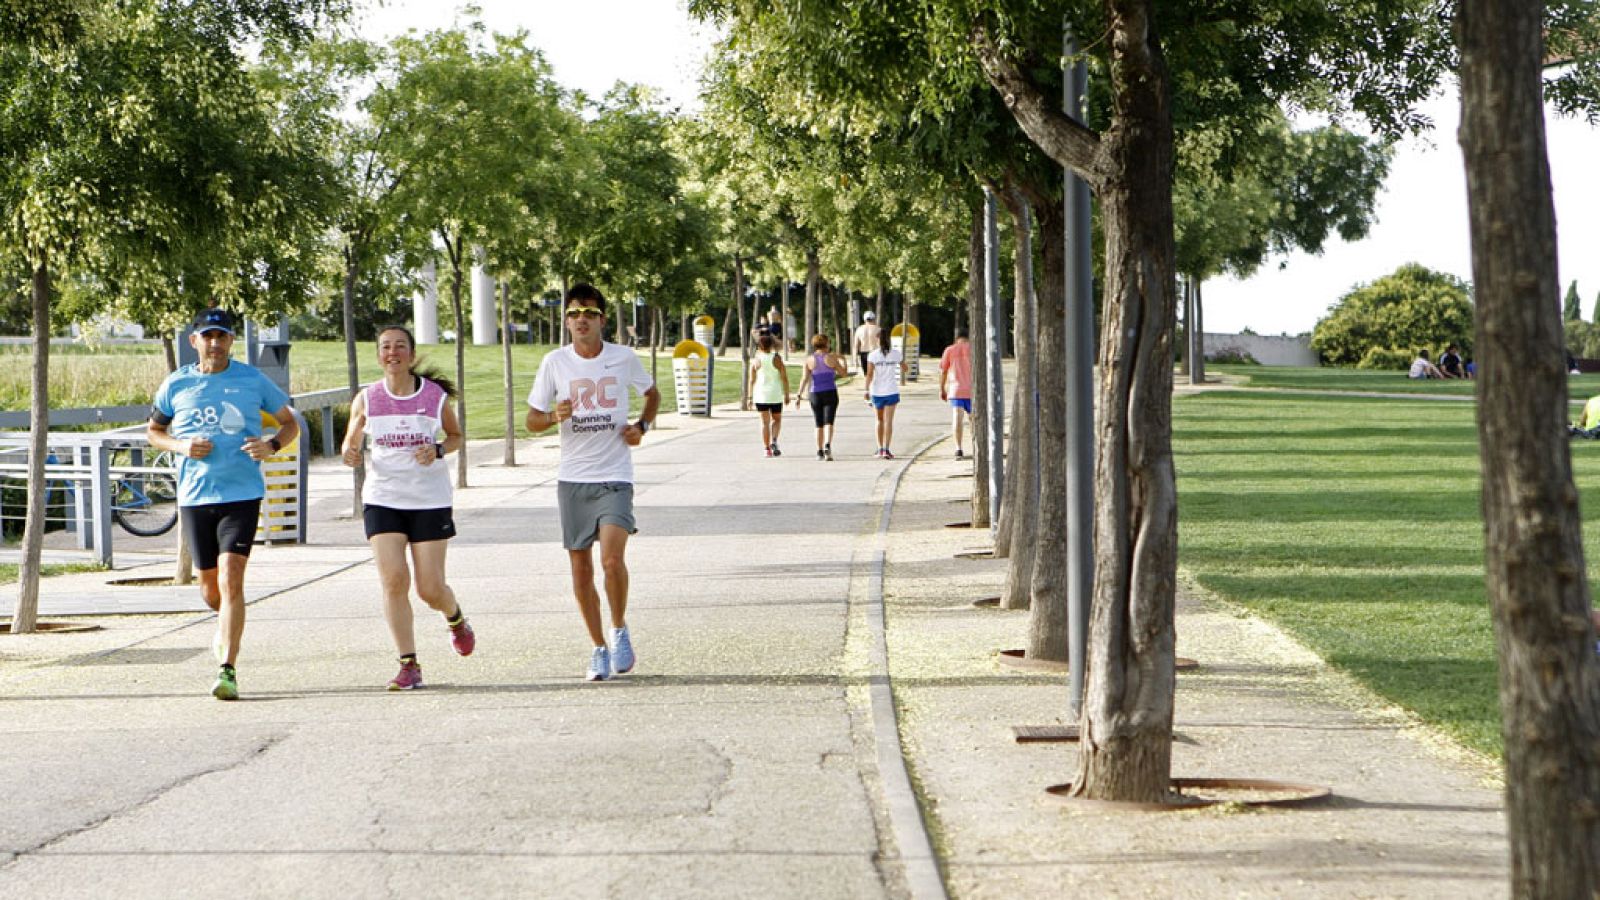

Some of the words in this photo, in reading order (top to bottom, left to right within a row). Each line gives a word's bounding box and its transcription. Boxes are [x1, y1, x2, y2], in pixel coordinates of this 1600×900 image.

[570, 377, 618, 410] RC
[191, 406, 218, 427] 38
[571, 414, 611, 424] Running
[571, 423, 616, 433] Company
